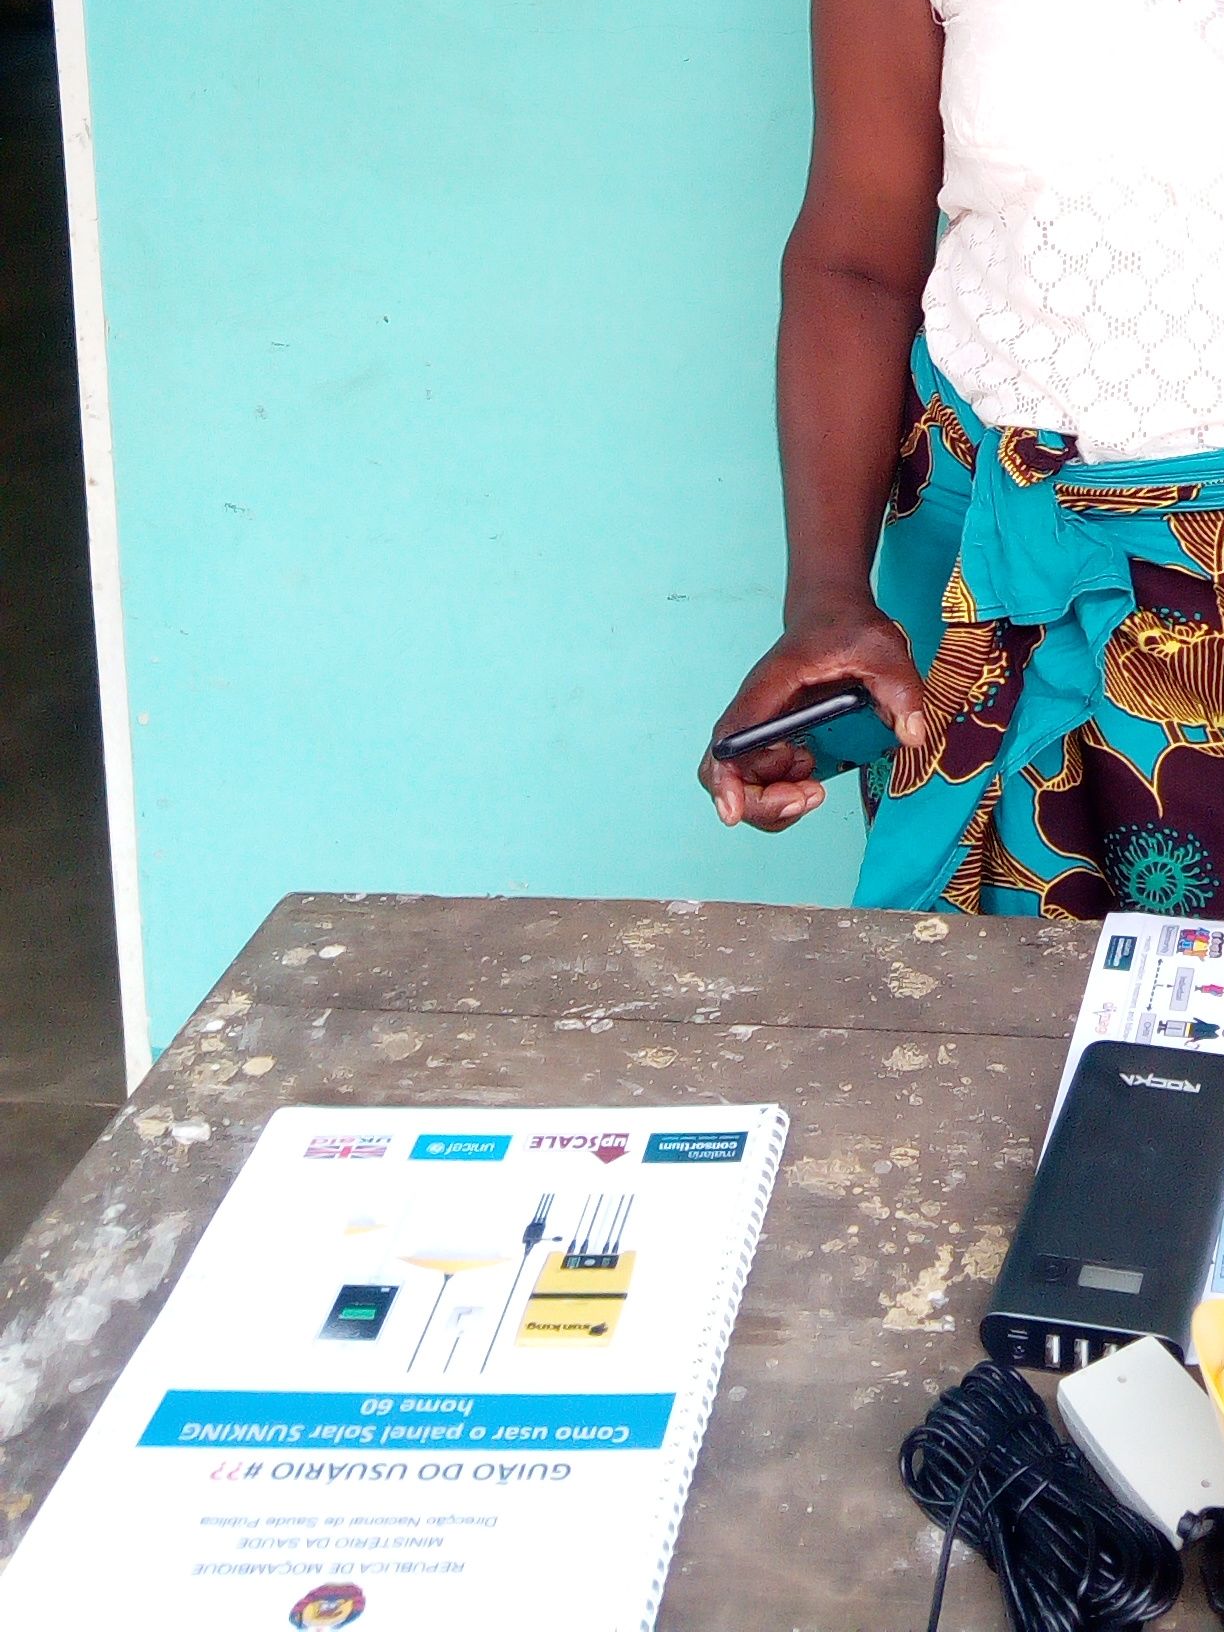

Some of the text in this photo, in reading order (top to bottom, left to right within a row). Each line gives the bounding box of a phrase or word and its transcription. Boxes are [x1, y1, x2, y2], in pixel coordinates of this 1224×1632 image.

[1119, 1073, 1201, 1093] ROCKA
[443, 1142, 495, 1156] unicef
[659, 1141, 738, 1152] consortium
[687, 1151, 736, 1160] malaria
[360, 1398, 474, 1418] home 60
[180, 1422, 631, 1444] Como usar o painel Solar SUNKING
[208, 1463, 572, 1486] GUIÃO DO USUÁRIO #??
[324, 1517, 346, 1528] de
[349, 1517, 421, 1529] Nacional
[426, 1515, 499, 1528] Direcção
[306, 1536, 332, 1548] DA
[335, 1536, 445, 1550] MINISTÉRIO
[191, 1560, 323, 1576] MOÇAMBIQUE
[331, 1562, 355, 1575] DE
